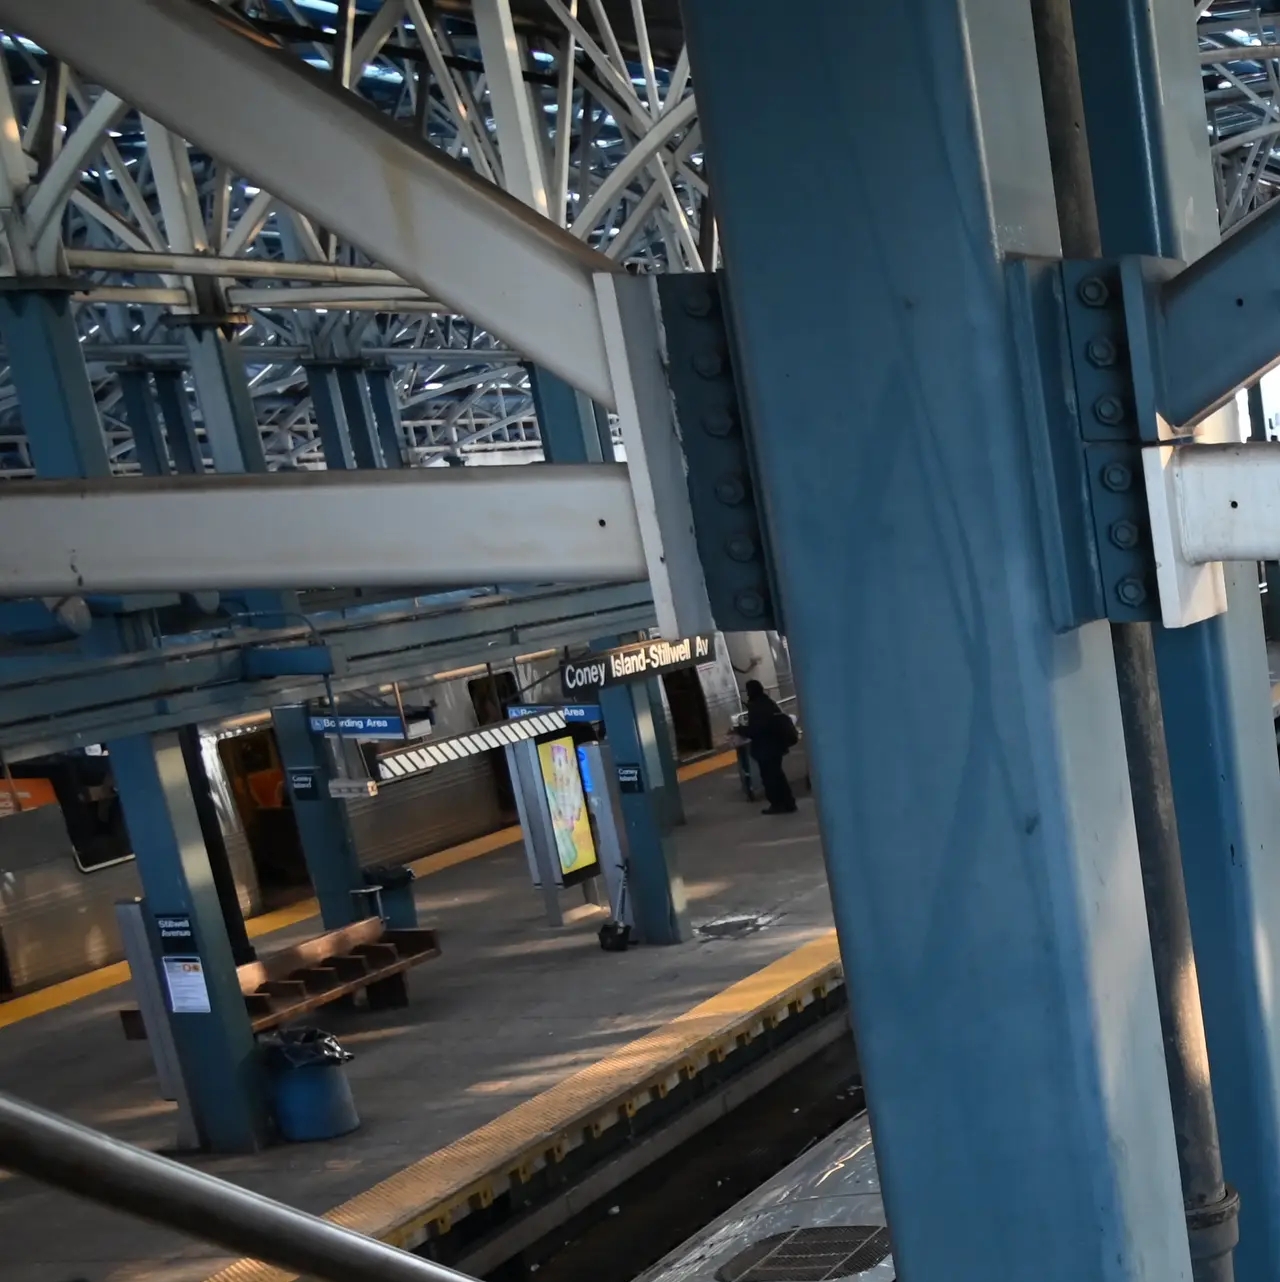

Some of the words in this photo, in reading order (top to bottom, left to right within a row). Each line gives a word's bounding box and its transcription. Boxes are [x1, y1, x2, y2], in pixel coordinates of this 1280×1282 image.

[565, 661, 606, 689] Coney
[611, 638, 691, 678] Island-Stillwell
[696, 636, 709, 657] Av
[564, 708, 584, 716] Area
[324, 719, 363, 729] Bording
[366, 718, 388, 727] Area
